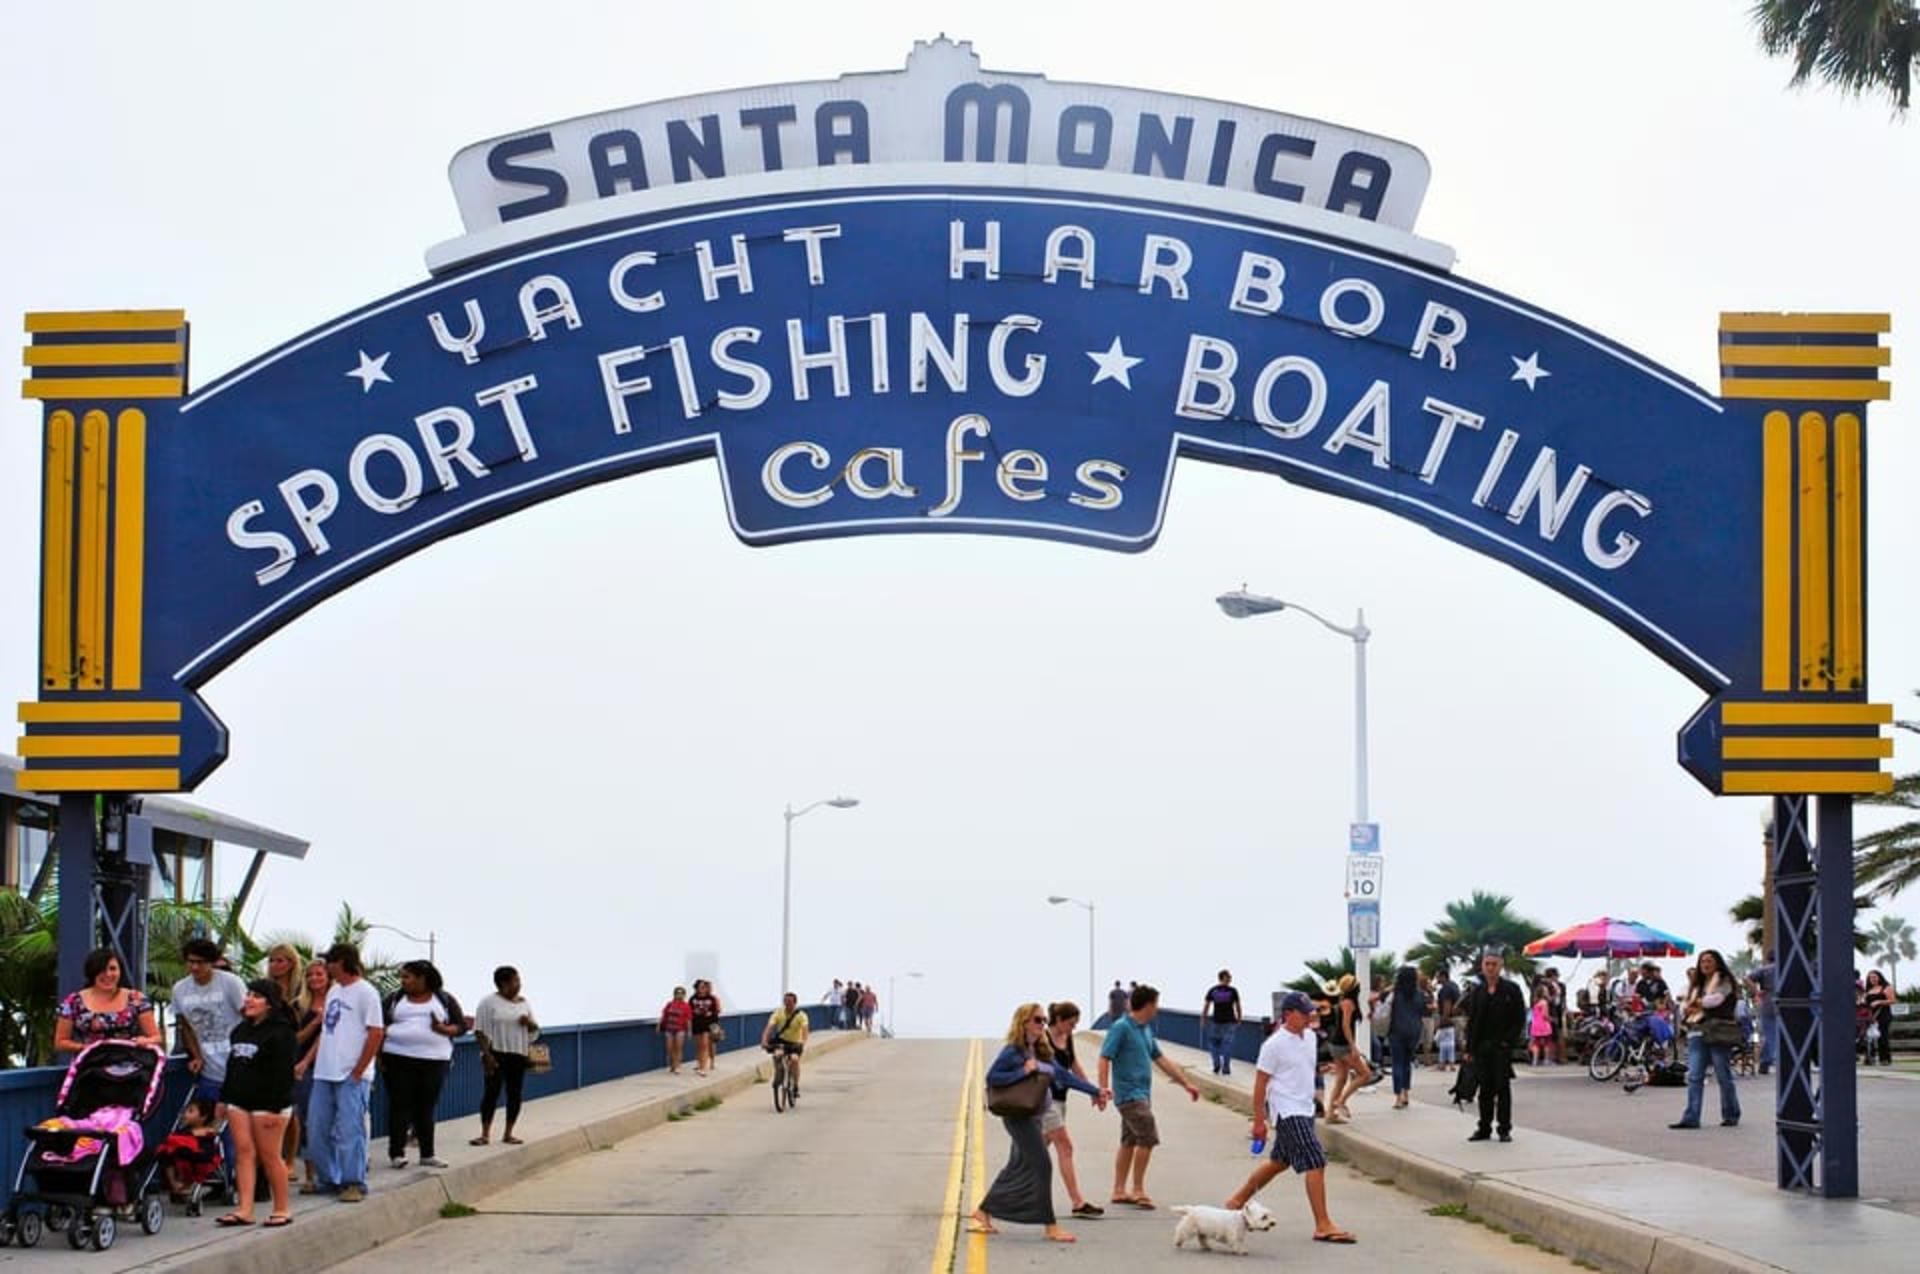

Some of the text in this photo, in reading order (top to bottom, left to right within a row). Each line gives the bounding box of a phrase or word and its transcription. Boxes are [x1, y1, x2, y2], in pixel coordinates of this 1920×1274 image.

[487, 83, 1392, 223] SANTA MONICA
[427, 219, 1468, 371] YACHT HARBOR
[226, 312, 1652, 586] SPORT FISHING BOATING
[1353, 880, 1375, 895] 10
